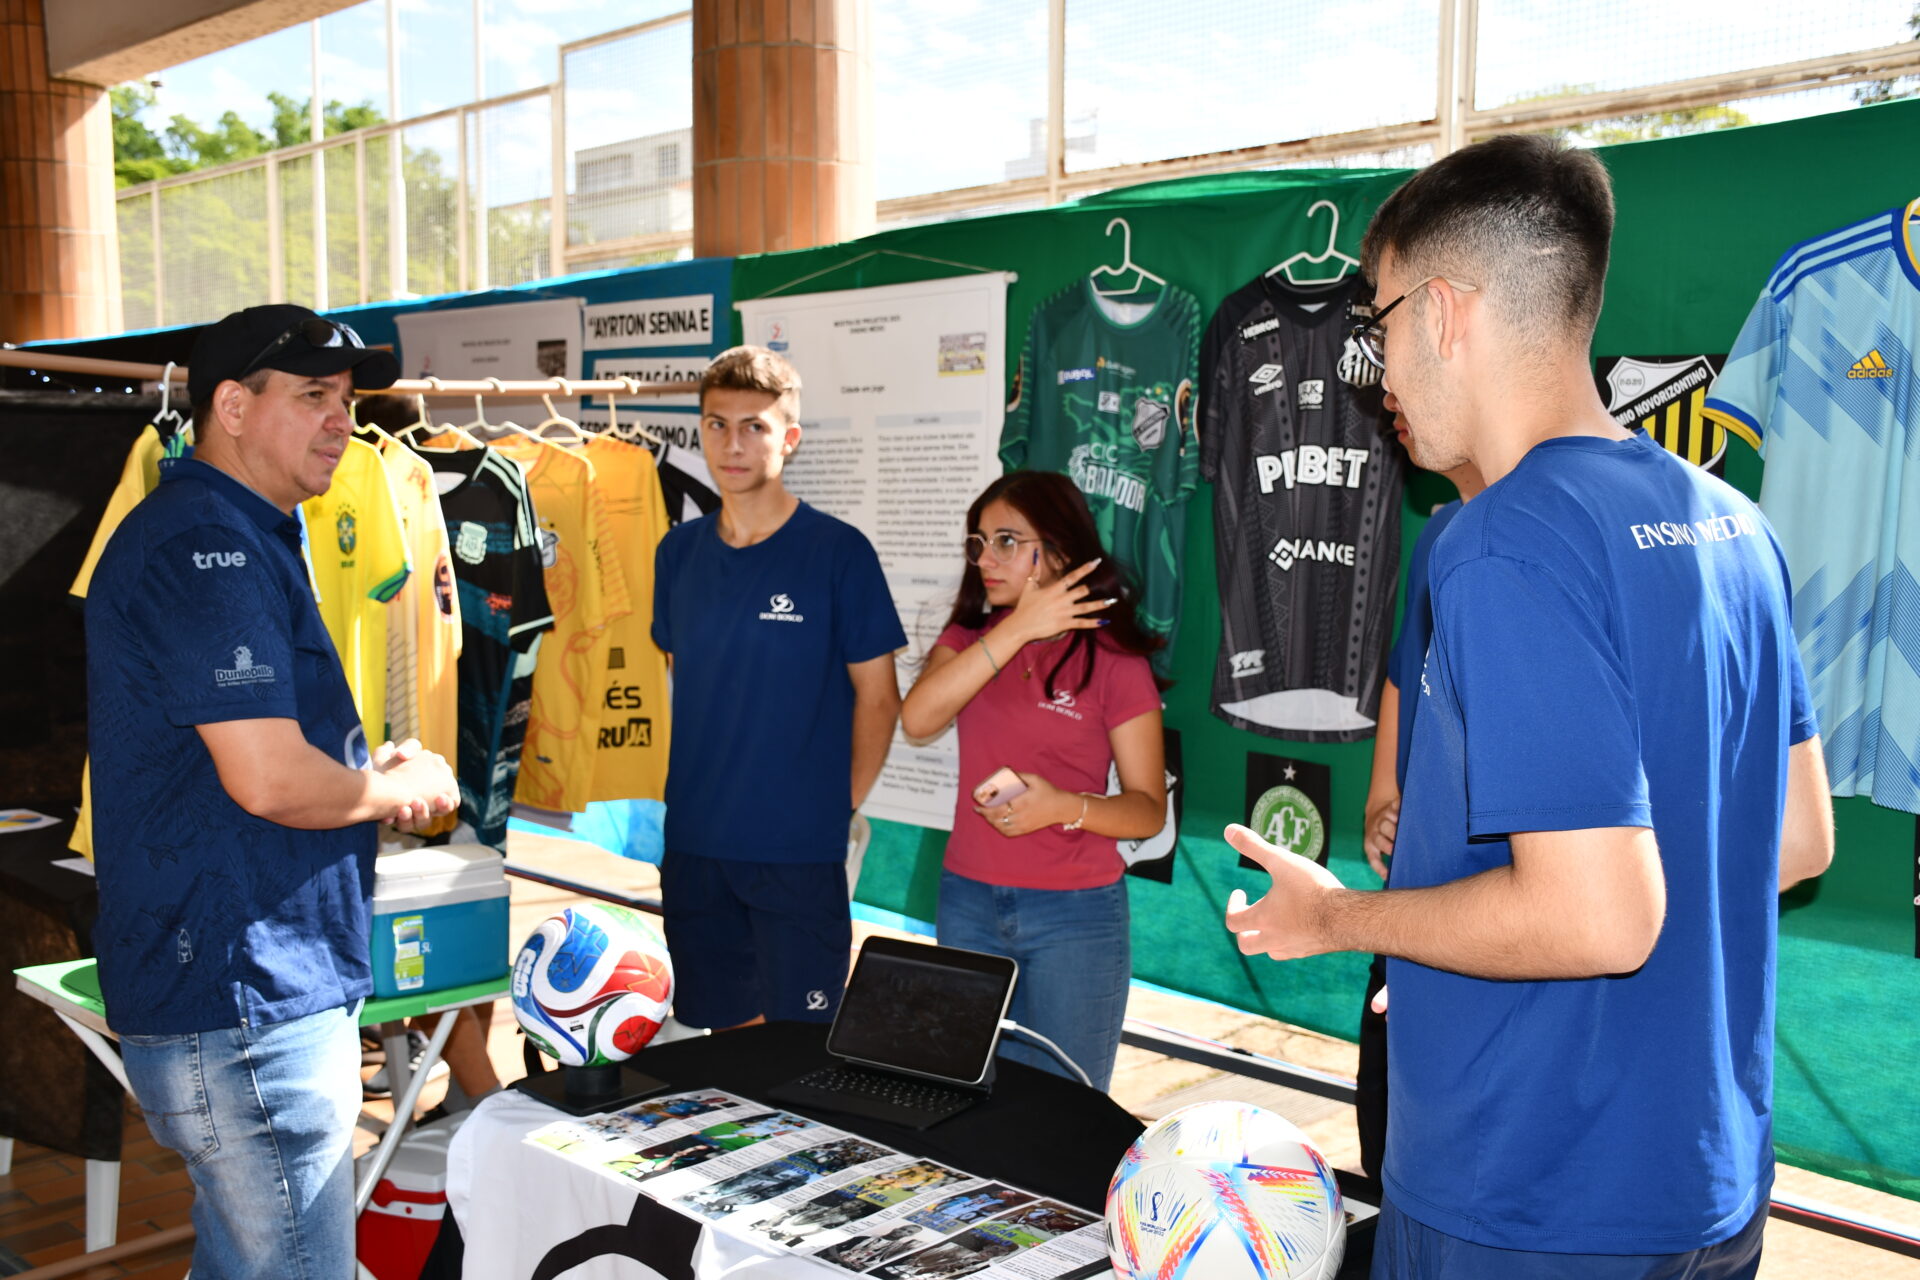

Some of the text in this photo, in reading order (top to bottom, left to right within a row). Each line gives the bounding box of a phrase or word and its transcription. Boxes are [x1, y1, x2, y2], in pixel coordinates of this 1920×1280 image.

[649, 309, 698, 335] SENNA
[701, 309, 709, 331] E
[1243, 318, 1280, 339] HEBRON
[1847, 368, 1893, 378] adidas
[1634, 366, 1708, 418] NOVORIZONTINO
[1090, 442, 1118, 463] CIC
[1630, 521, 1697, 549] ENSINO
[192, 551, 247, 570] true
[215, 665, 275, 682] Dunlopillo
